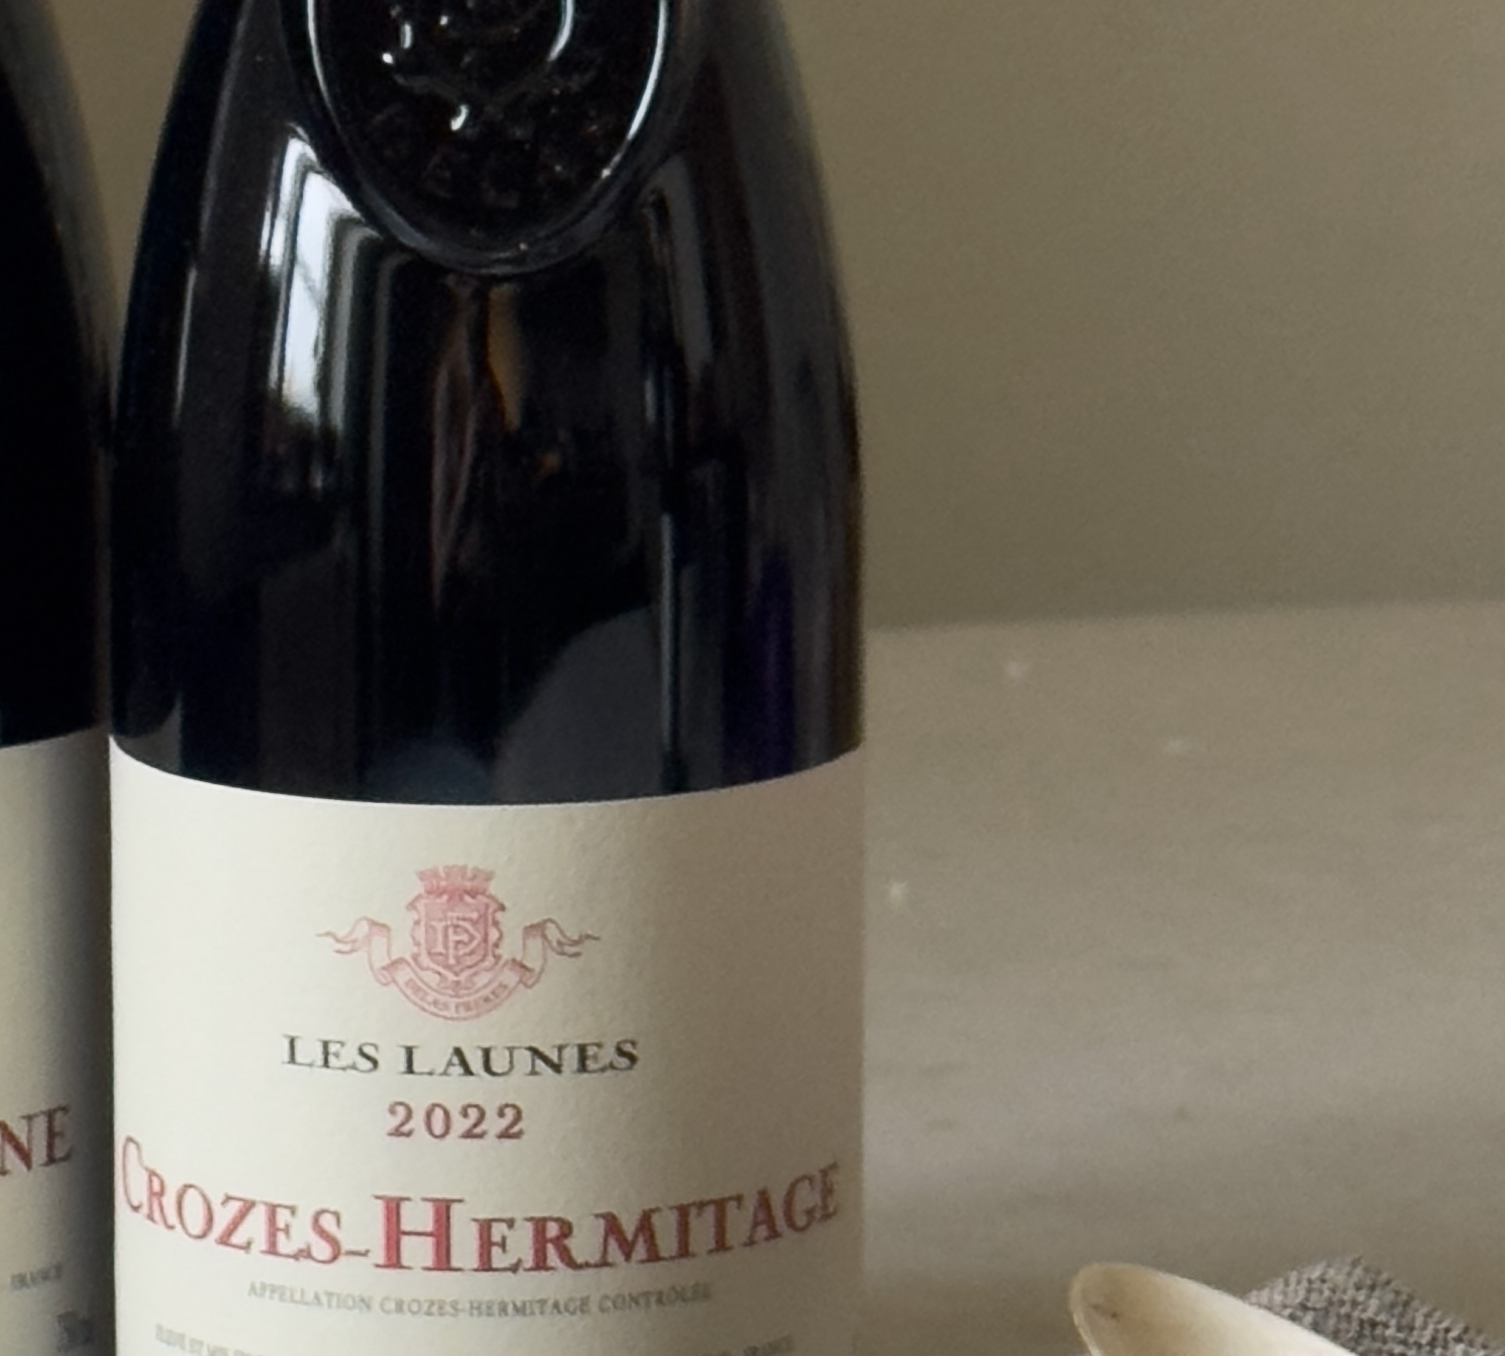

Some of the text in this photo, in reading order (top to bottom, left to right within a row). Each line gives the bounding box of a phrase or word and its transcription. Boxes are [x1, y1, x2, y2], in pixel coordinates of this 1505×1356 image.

[281, 1034, 639, 1078] LES LAUNES
[387, 1102, 525, 1140] 2022
[122, 1136, 838, 1273] CROZES-HERMITAGE
[248, 1281, 372, 1313] APPELLATION
[380, 1295, 590, 1318] CROZES-HERMITAGE
